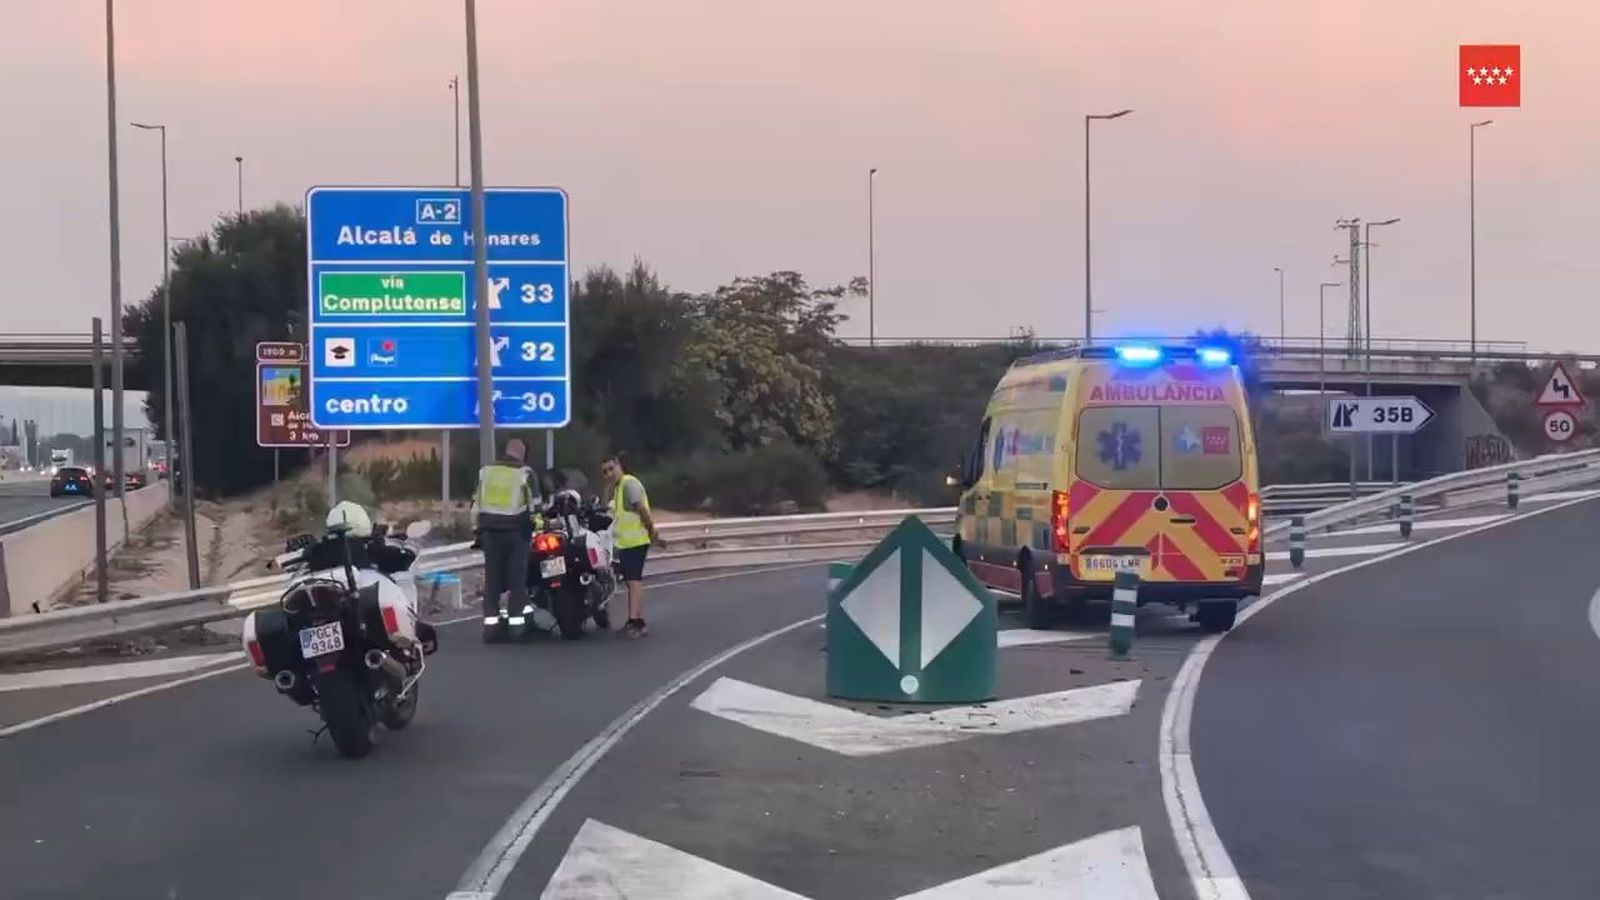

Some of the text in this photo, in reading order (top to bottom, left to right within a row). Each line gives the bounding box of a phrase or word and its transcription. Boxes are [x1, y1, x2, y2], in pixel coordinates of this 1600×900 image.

[420, 203, 457, 220] A-2
[337, 225, 541, 246] Alcalá de Hnares
[520, 283, 554, 304] 33
[323, 294, 462, 313] Complutense
[521, 341, 556, 362] 32
[521, 391, 556, 412] 30
[1089, 384, 1226, 401] AMBULANCIA
[325, 394, 409, 413] centro
[1373, 407, 1414, 423] 35B
[1549, 420, 1571, 433] 50
